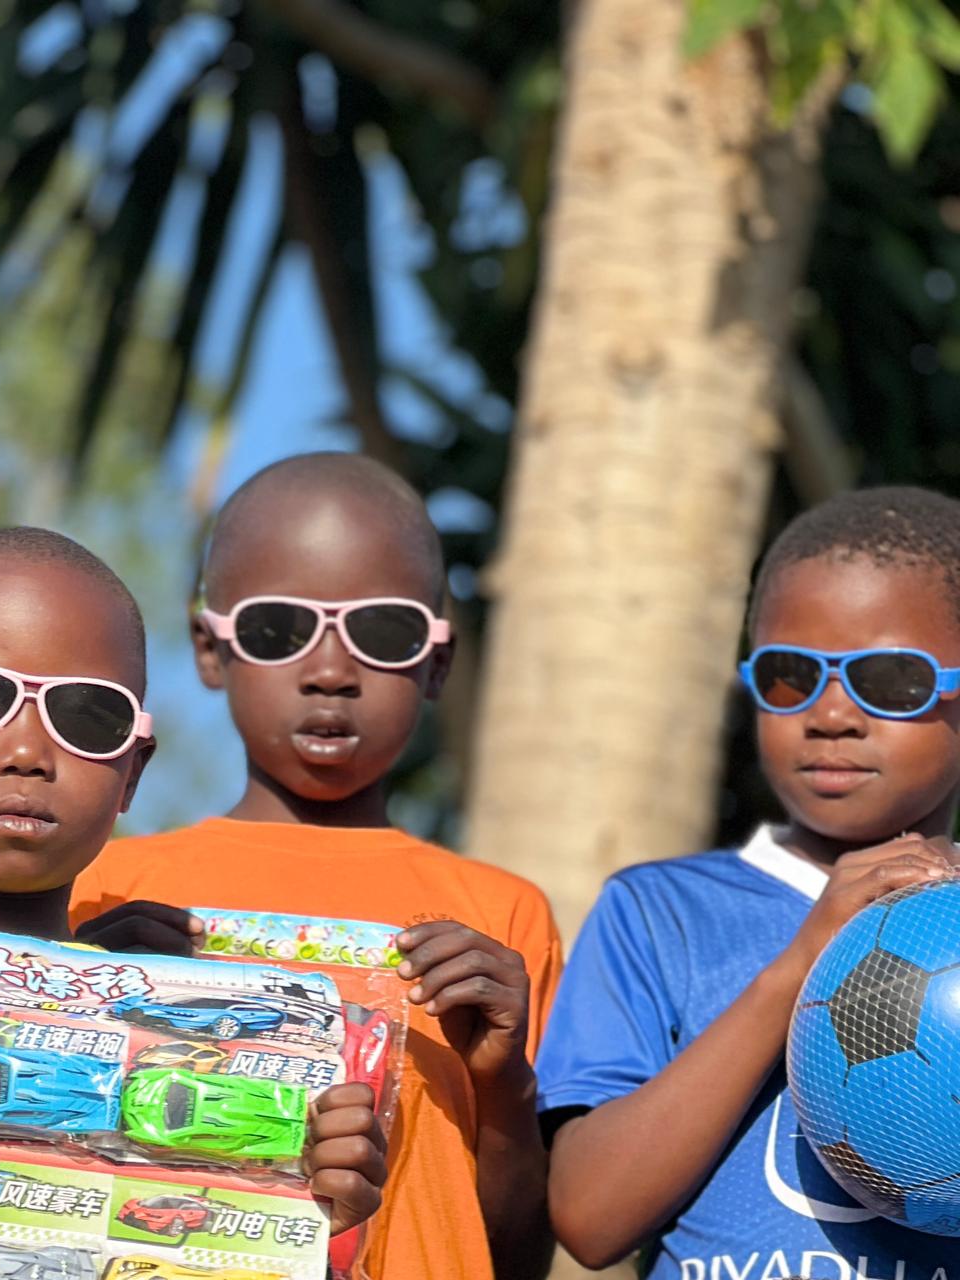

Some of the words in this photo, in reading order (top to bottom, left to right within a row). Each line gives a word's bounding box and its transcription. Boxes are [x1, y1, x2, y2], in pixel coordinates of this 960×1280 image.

[41, 1001, 99, 1016] Drift
[14, 1023, 125, 1059] 狂速酷跑
[229, 1049, 337, 1088] 风速豪车
[208, 1207, 320, 1247] 闪电飞车
